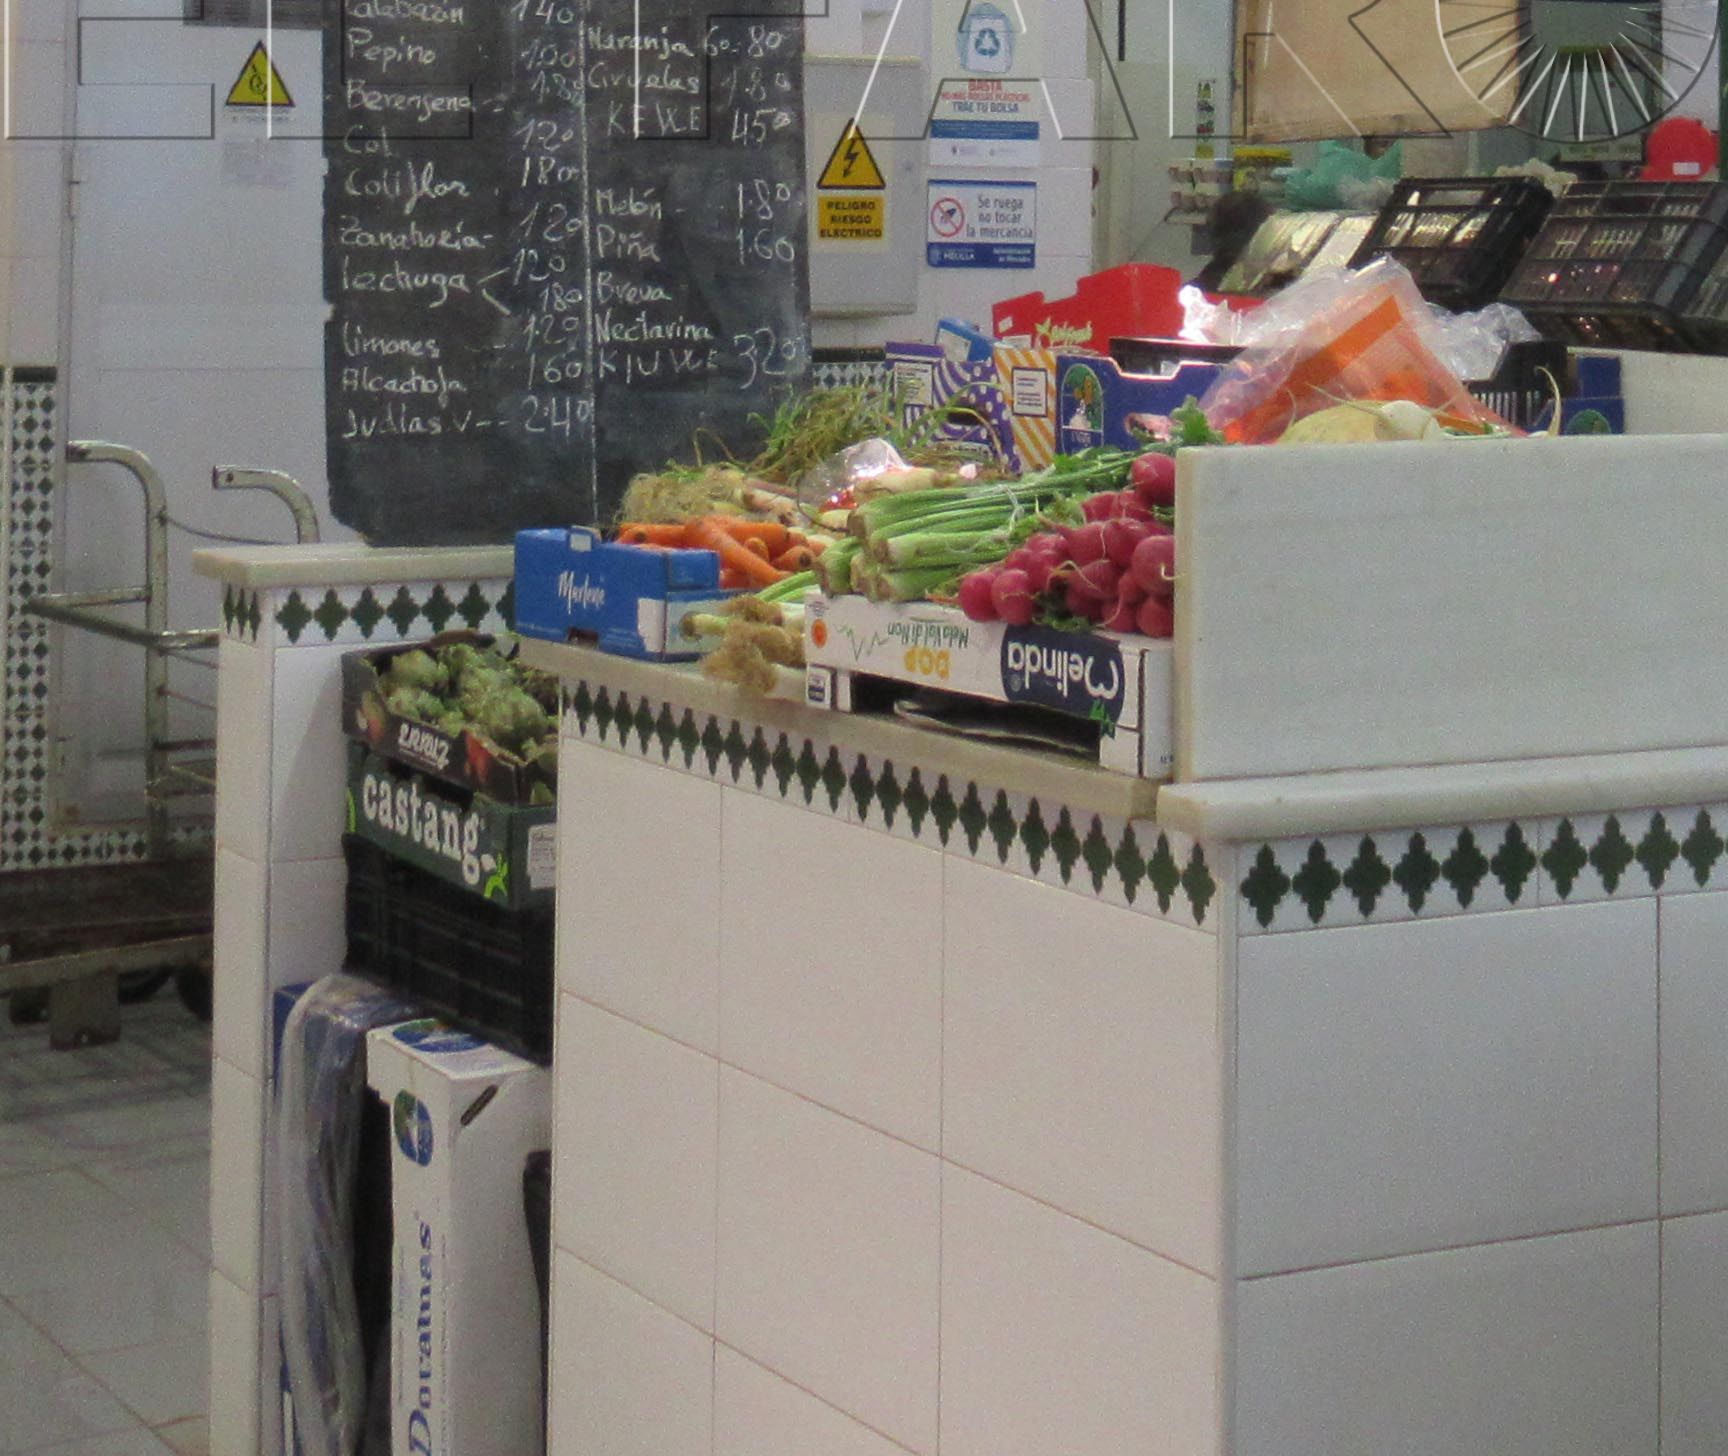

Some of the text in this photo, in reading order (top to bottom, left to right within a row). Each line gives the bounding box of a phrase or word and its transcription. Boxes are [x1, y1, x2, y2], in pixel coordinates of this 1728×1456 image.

[347, 27, 437, 73] Pepino
[587, 24, 695, 61] Naranja
[588, 61, 700, 94] Ciruelas
[343, 124, 393, 157] Col
[827, 201, 875, 210] PELIGRO
[831, 215, 871, 224] RIESGO
[978, 193, 1023, 212] Se ruega
[978, 212, 1022, 224] no tocar
[595, 224, 661, 263] Piña
[594, 307, 714, 344] Nectarina
[558, 570, 606, 615] Marlene
[903, 646, 951, 680] DOP
[1006, 640, 1120, 701] Melinda
[362, 774, 481, 886] castang
